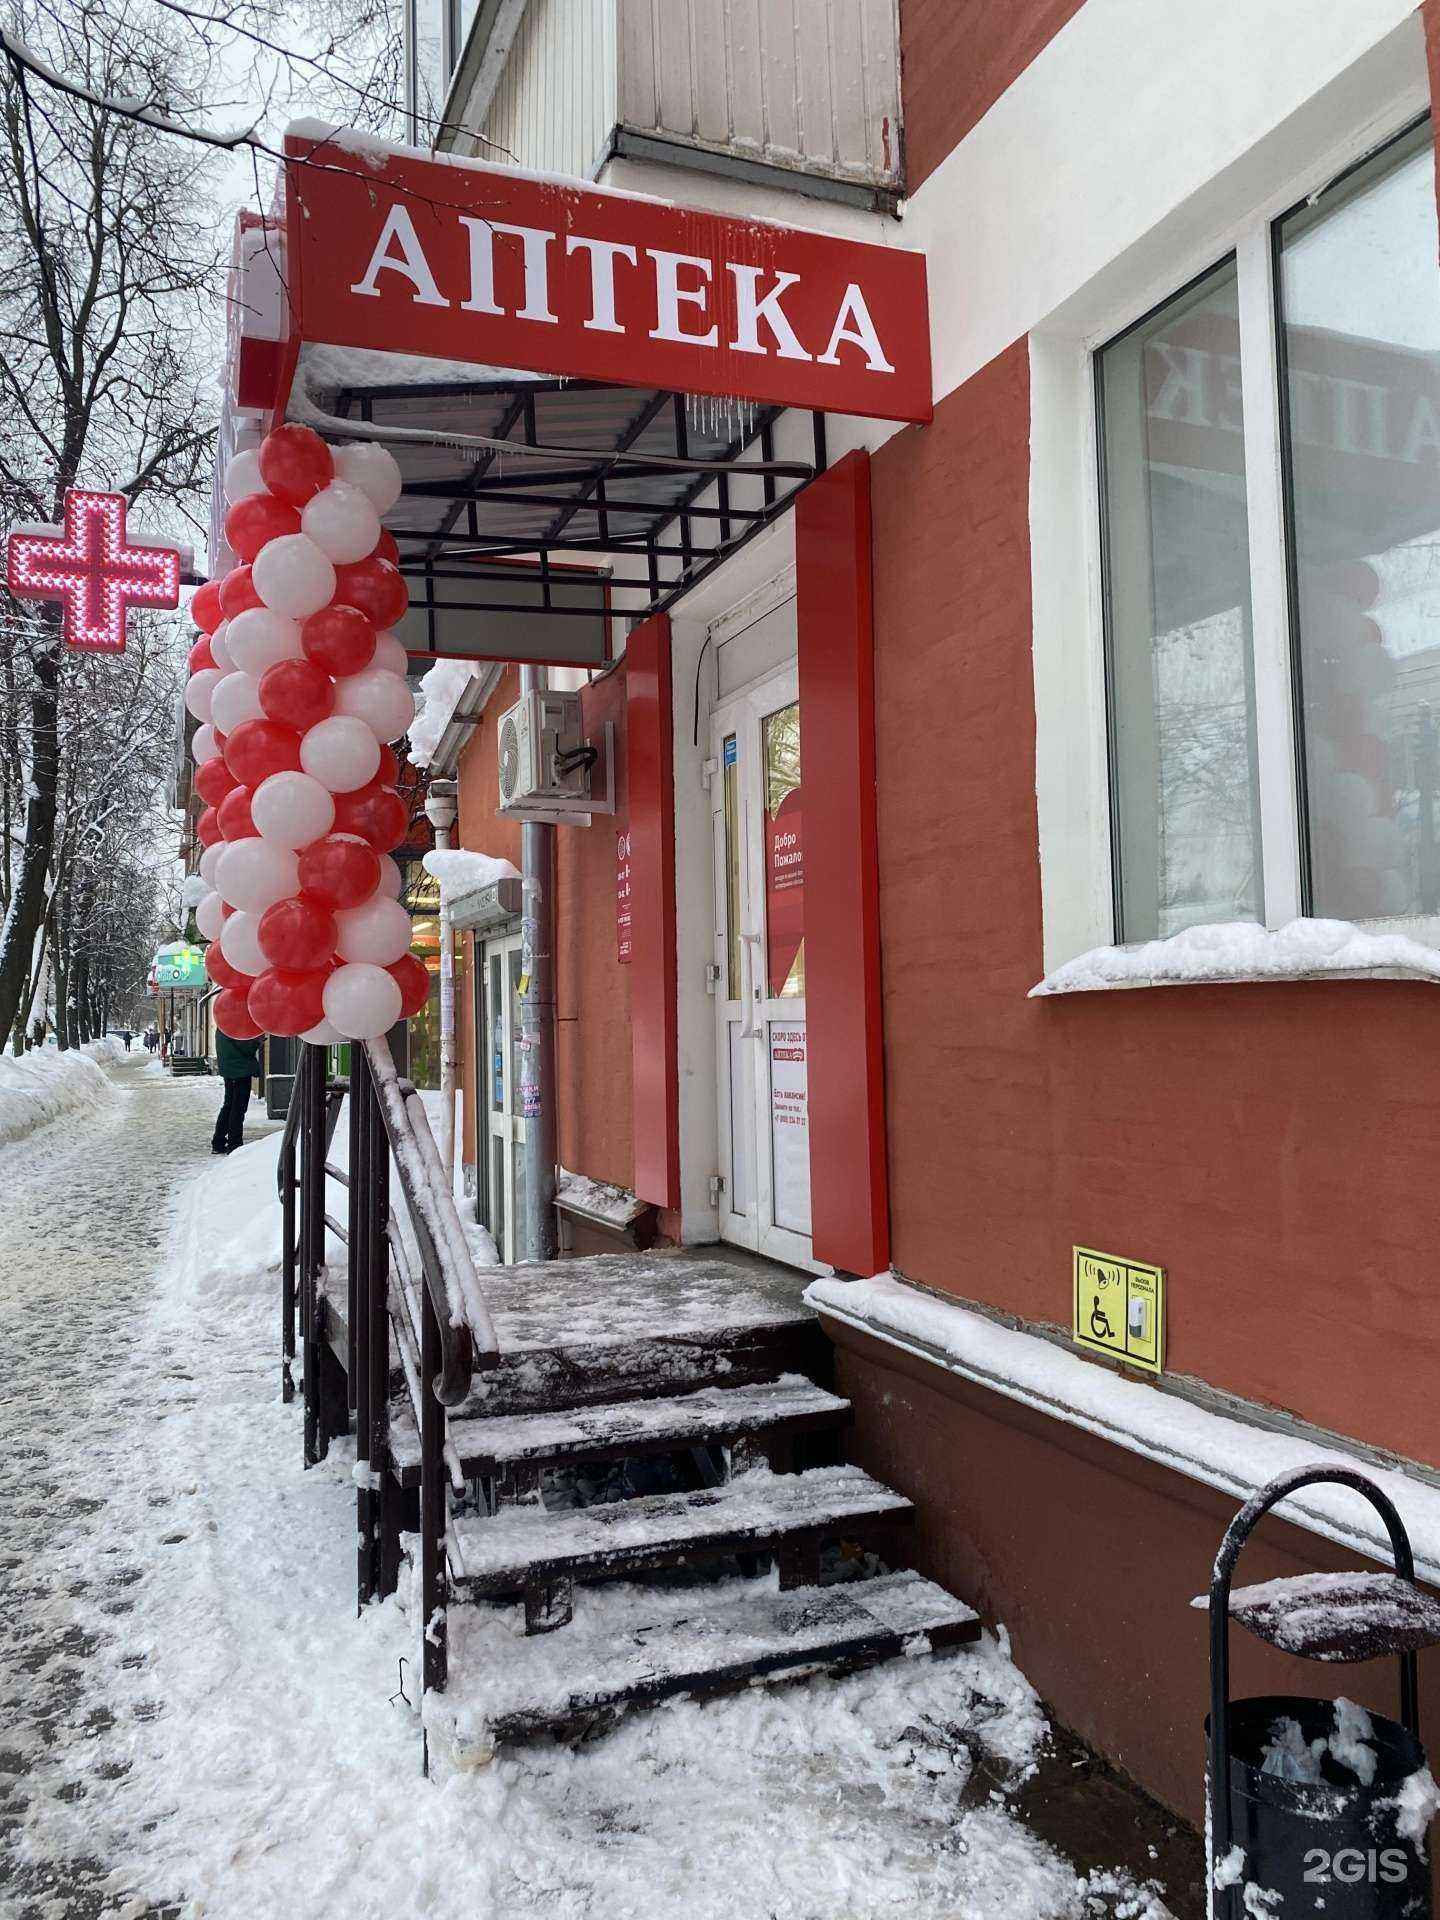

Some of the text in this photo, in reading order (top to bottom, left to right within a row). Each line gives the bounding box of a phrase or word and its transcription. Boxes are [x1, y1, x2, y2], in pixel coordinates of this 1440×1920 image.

[350, 203, 896, 374] АПТЕКА
[774, 833, 796, 850] Добро
[774, 852, 804, 868] Пожало
